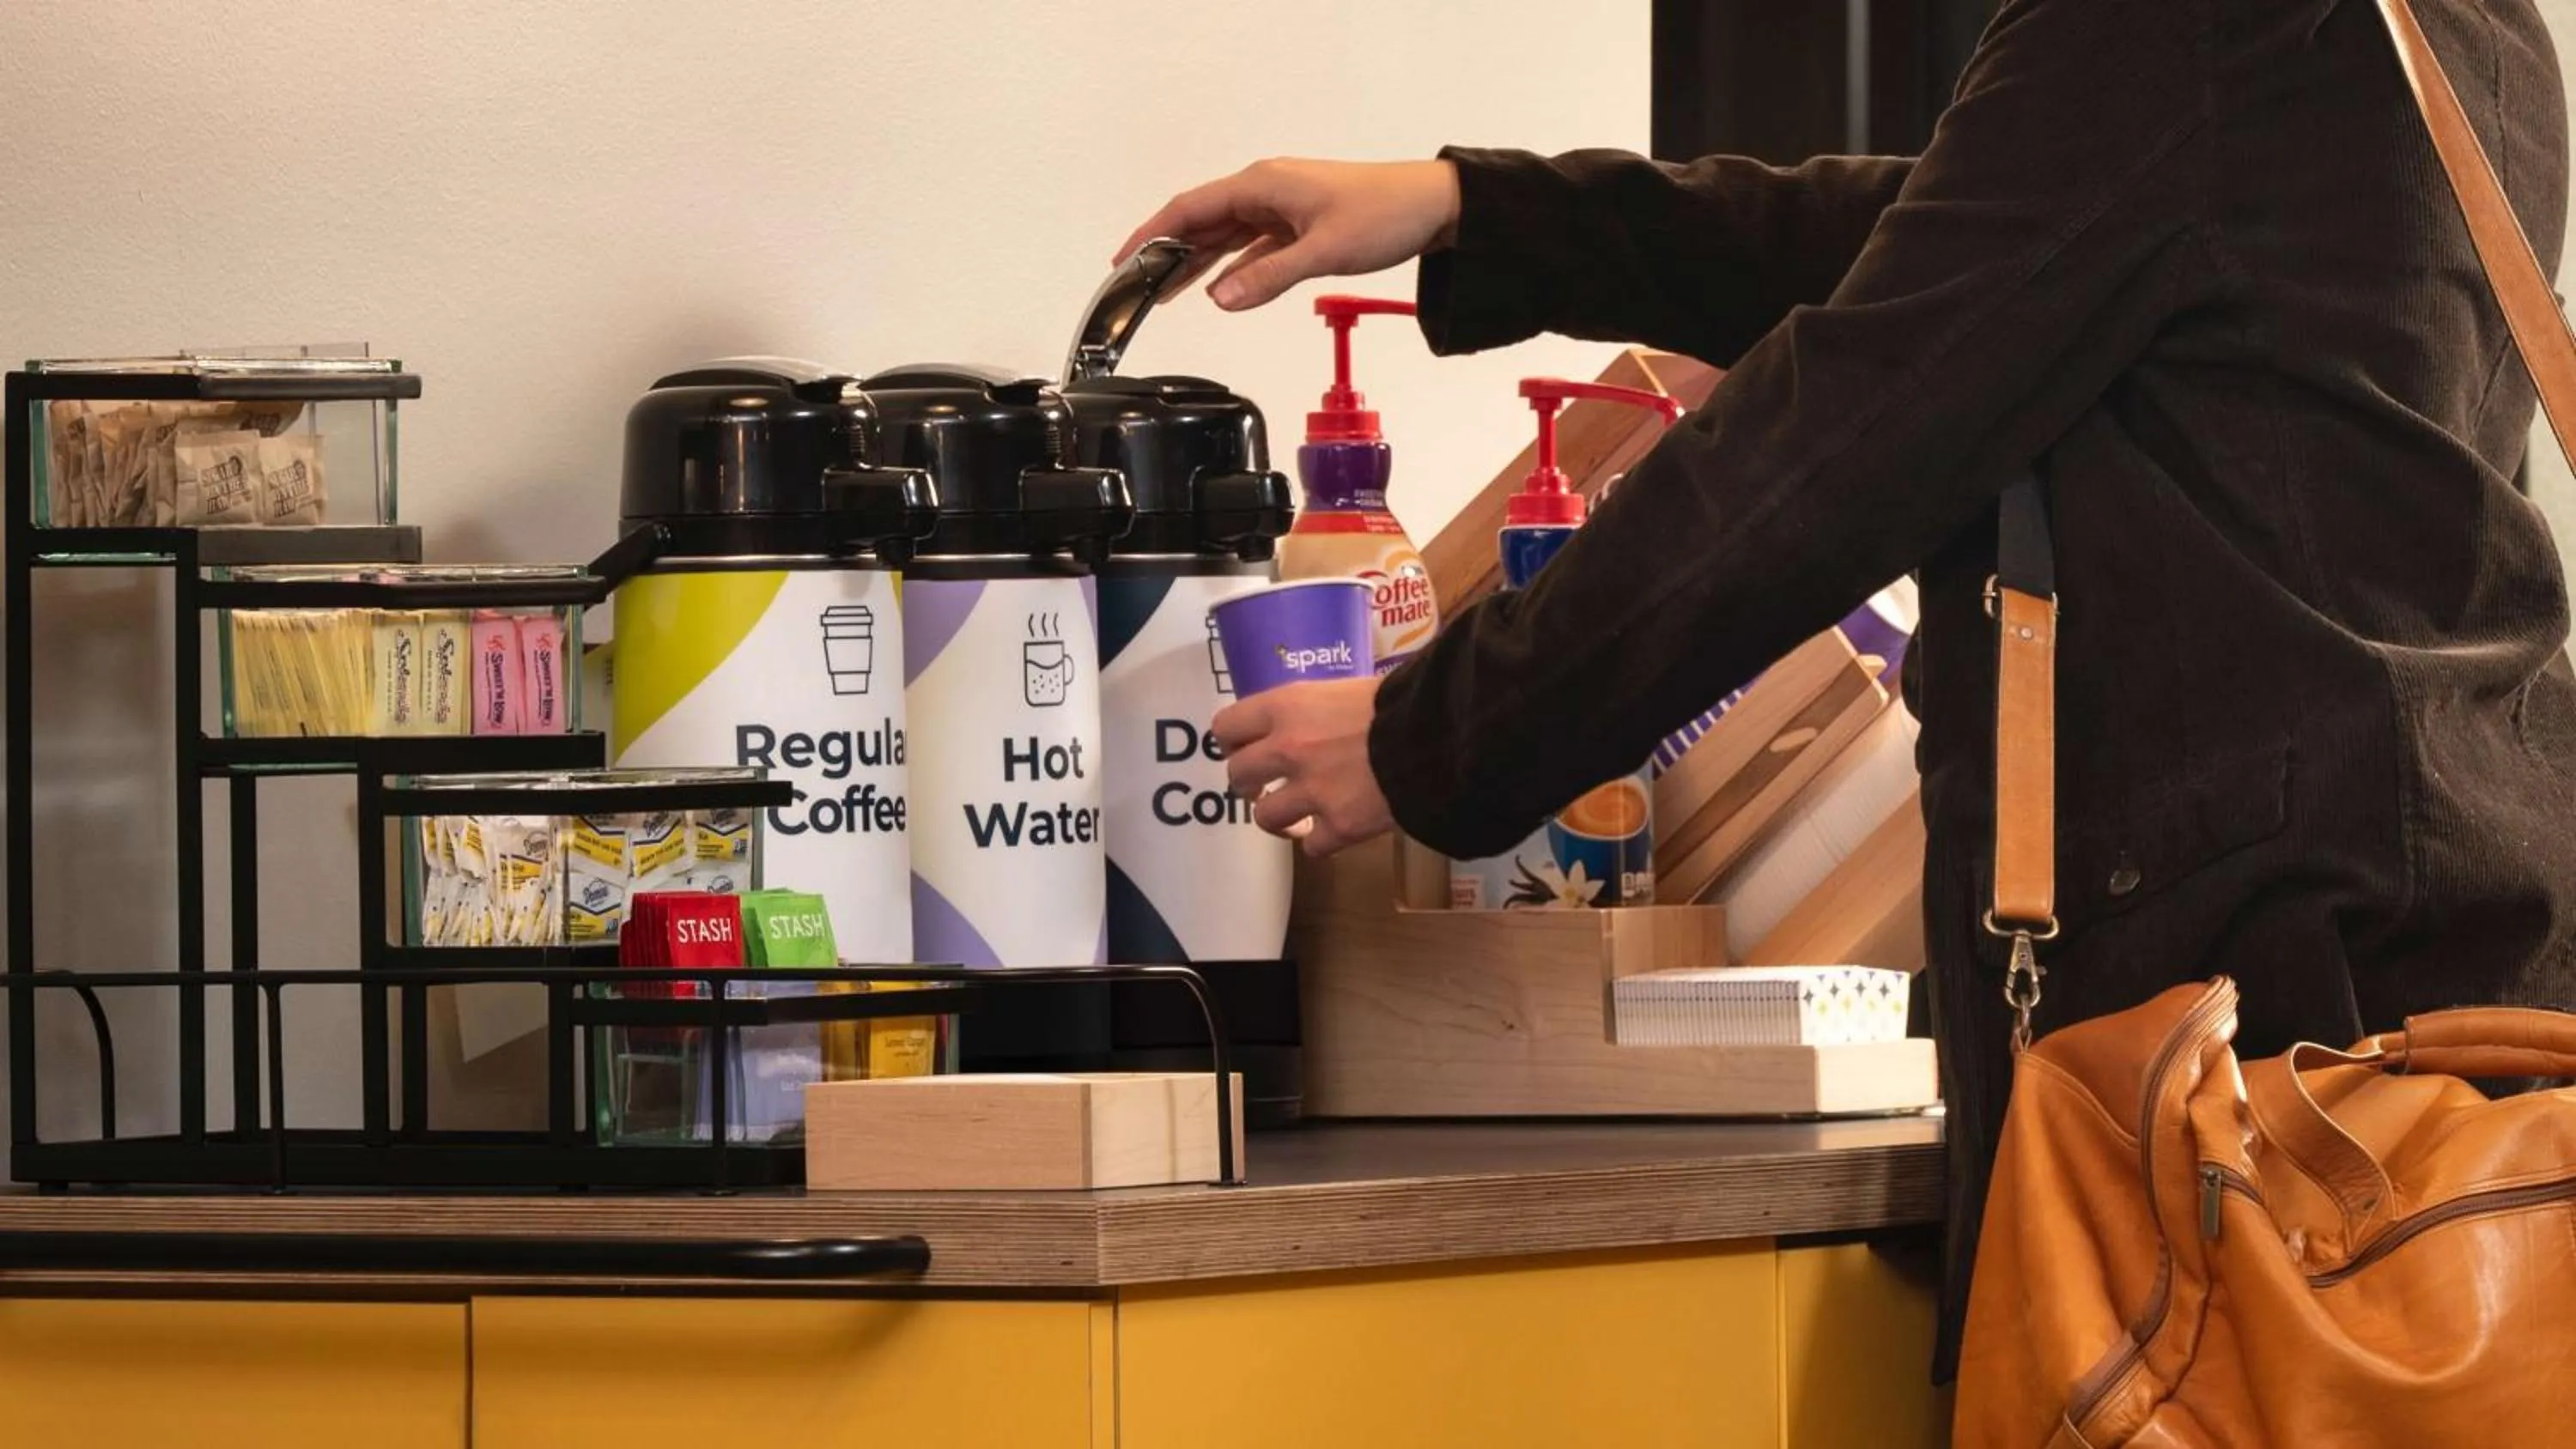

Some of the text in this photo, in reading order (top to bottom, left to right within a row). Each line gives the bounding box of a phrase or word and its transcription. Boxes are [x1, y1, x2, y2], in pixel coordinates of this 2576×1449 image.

[1381, 599, 1431, 627] mate
[1286, 640, 1353, 674] spark
[736, 718, 907, 779] Regula
[1003, 737, 1084, 782] Hot
[767, 783, 906, 836] Coffee
[963, 801, 1100, 848] Water
[677, 917, 734, 944] STASH
[769, 913, 825, 940] STASH
